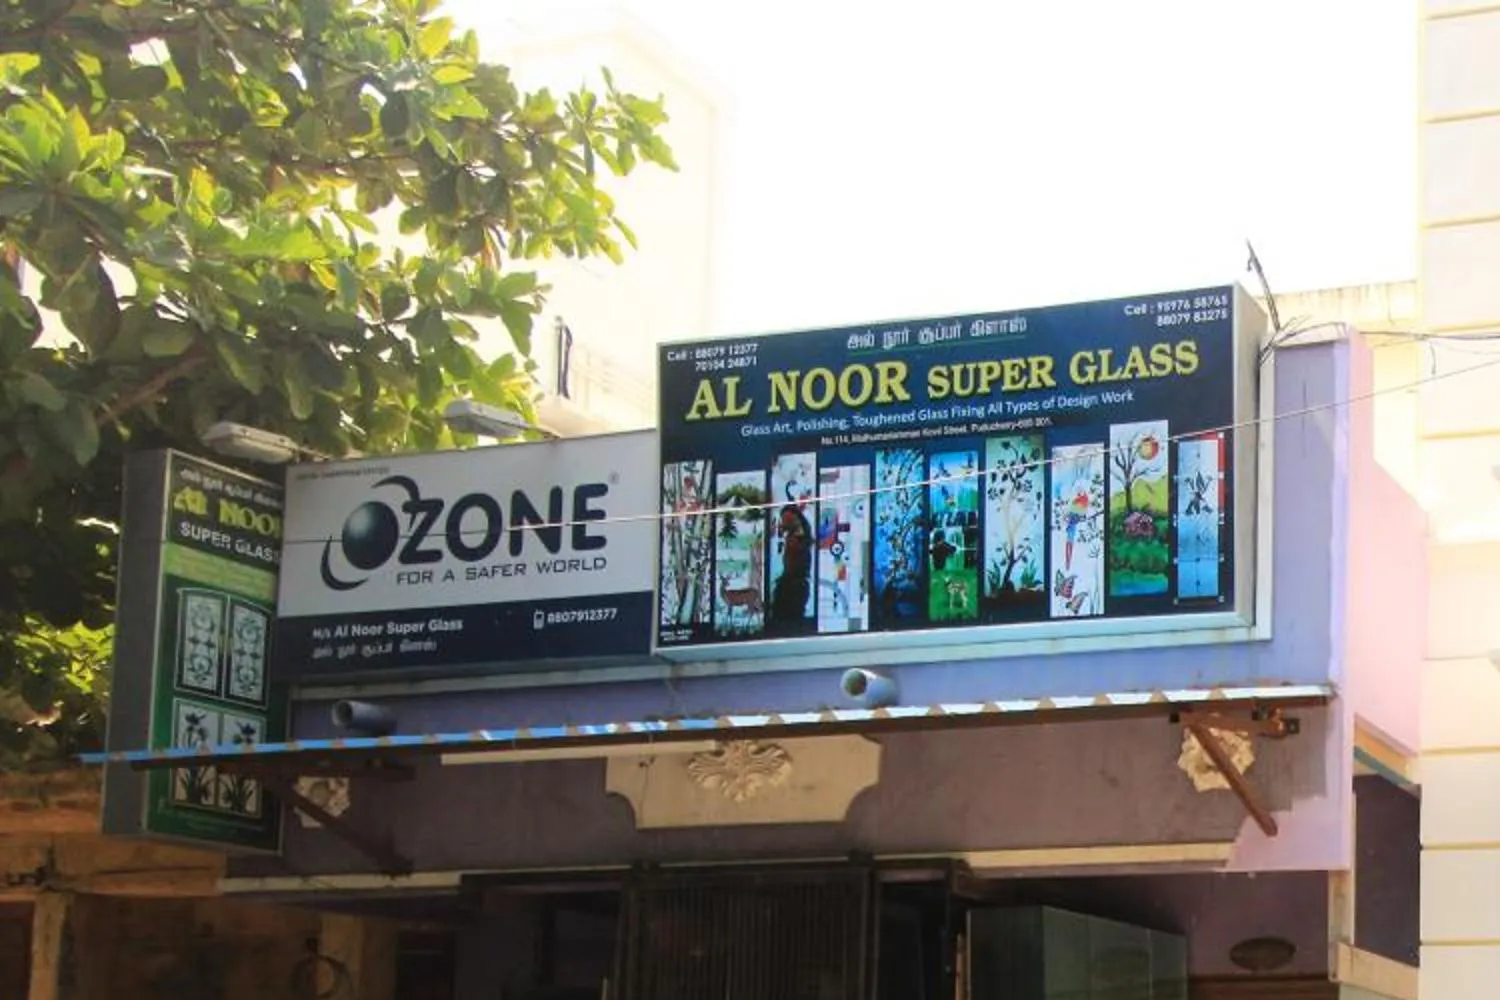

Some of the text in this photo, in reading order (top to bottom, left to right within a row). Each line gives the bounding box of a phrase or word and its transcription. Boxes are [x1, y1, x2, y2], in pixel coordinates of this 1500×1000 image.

[1124, 303, 1147, 316] Cell
[686, 341, 1199, 421] AL NOOR SUPER GLASS
[741, 424, 770, 437] Glass
[853, 410, 915, 428] Toughened
[918, 408, 948, 422] Glass
[952, 404, 985, 421] Fixing
[987, 402, 1002, 414] All
[1006, 399, 1039, 415] Types
[1041, 397, 1055, 409] of
[1058, 393, 1098, 409] Design
[1101, 389, 1134, 403] Work
[180, 521, 231, 550] SUPER
[397, 557, 607, 585] FOR A SAFER WORLD
[335, 624, 348, 637] Al
[351, 624, 383, 636] Noor
[387, 621, 425, 634] Super
[428, 619, 462, 631] Glass
